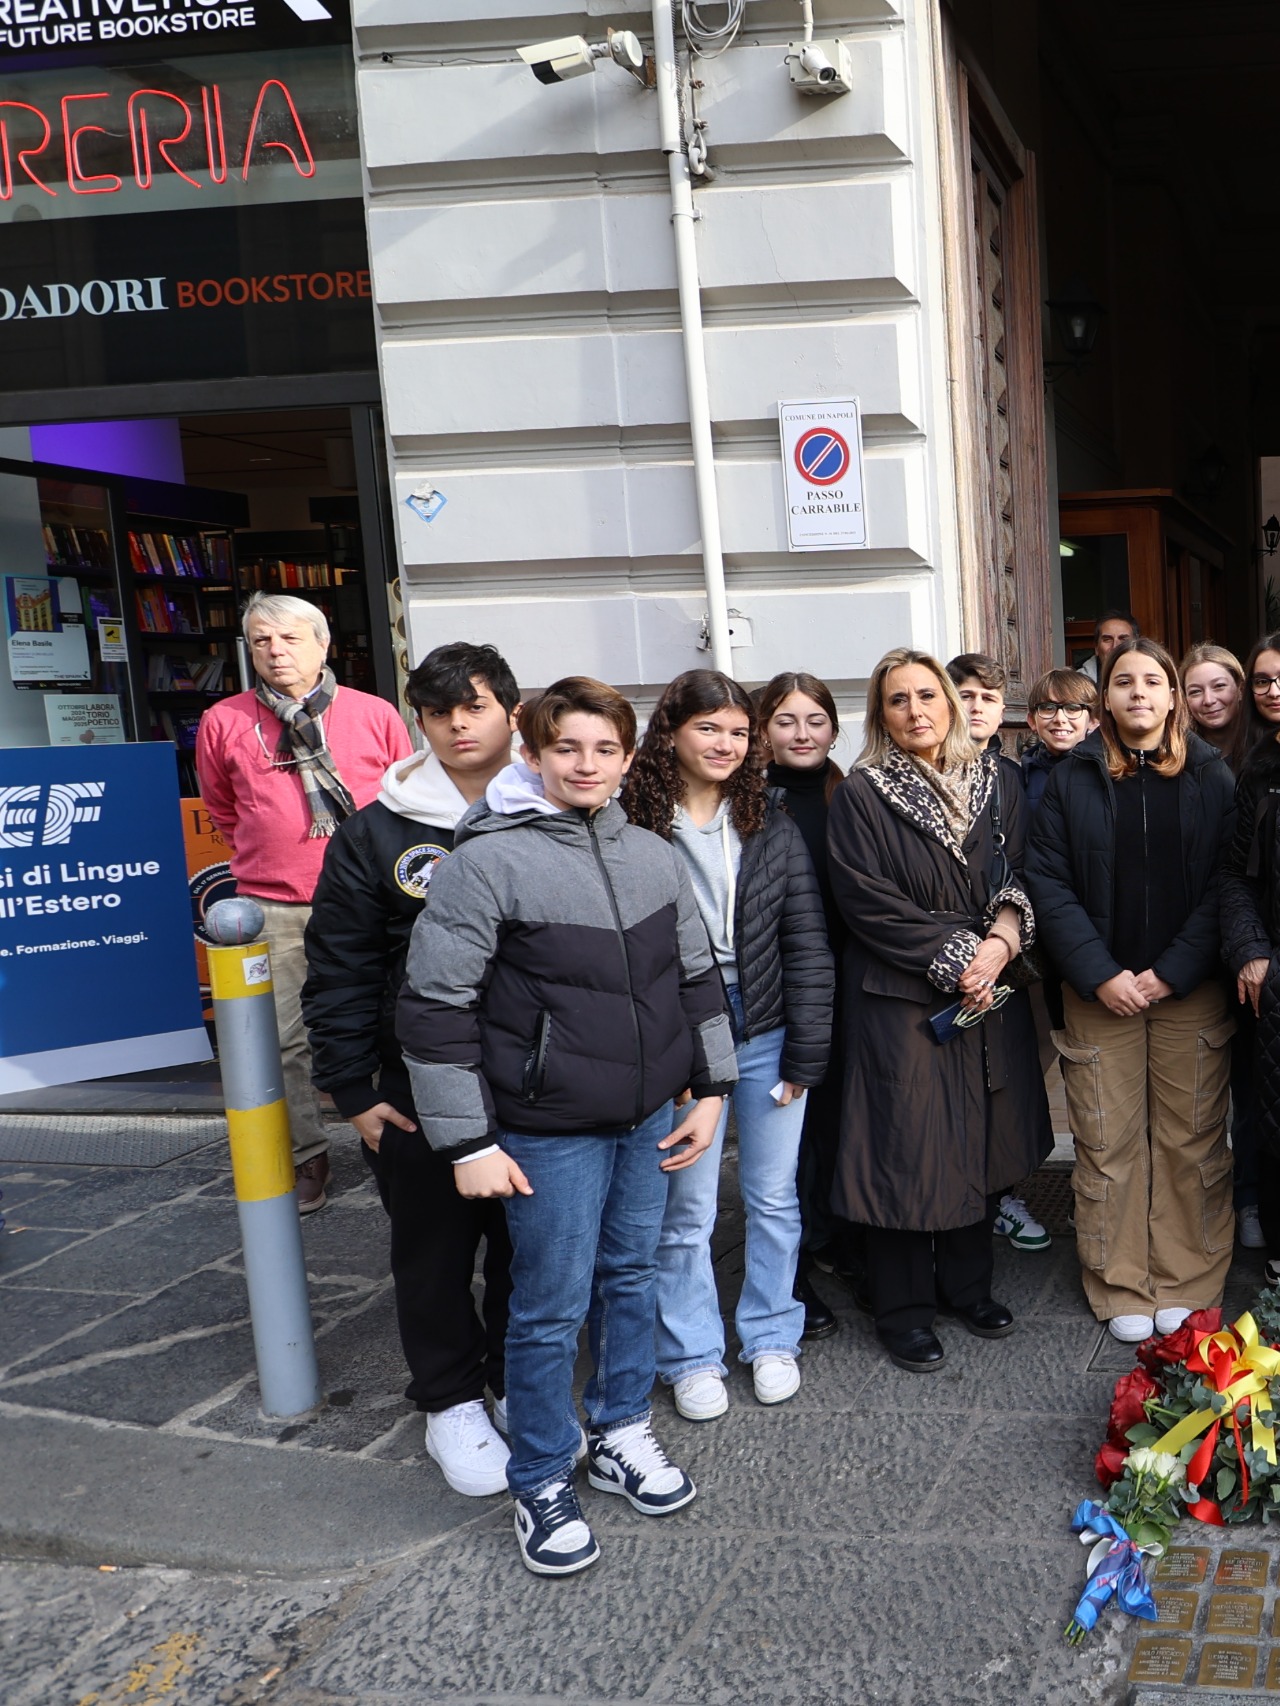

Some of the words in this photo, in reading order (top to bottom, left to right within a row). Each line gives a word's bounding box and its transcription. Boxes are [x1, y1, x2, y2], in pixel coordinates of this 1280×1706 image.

[99, 7, 257, 40] BOOKSTORE
[177, 271, 372, 309] BOOKSTORE
[785, 413, 816, 422] COMUNE
[827, 411, 854, 420] NAPOLI
[807, 489, 844, 501] PASSO
[791, 502, 862, 515] CARRABILE
[11, 639, 31, 647] Elena
[32, 640, 53, 648] Basile
[86, 703, 115, 711] LABORA
[87, 718, 120, 726] POETICO
[22, 863, 52, 886] di
[60, 860, 160, 884] Lingue
[16, 938, 101, 956] Formazione.
[102, 931, 150, 946] Viaggi.
